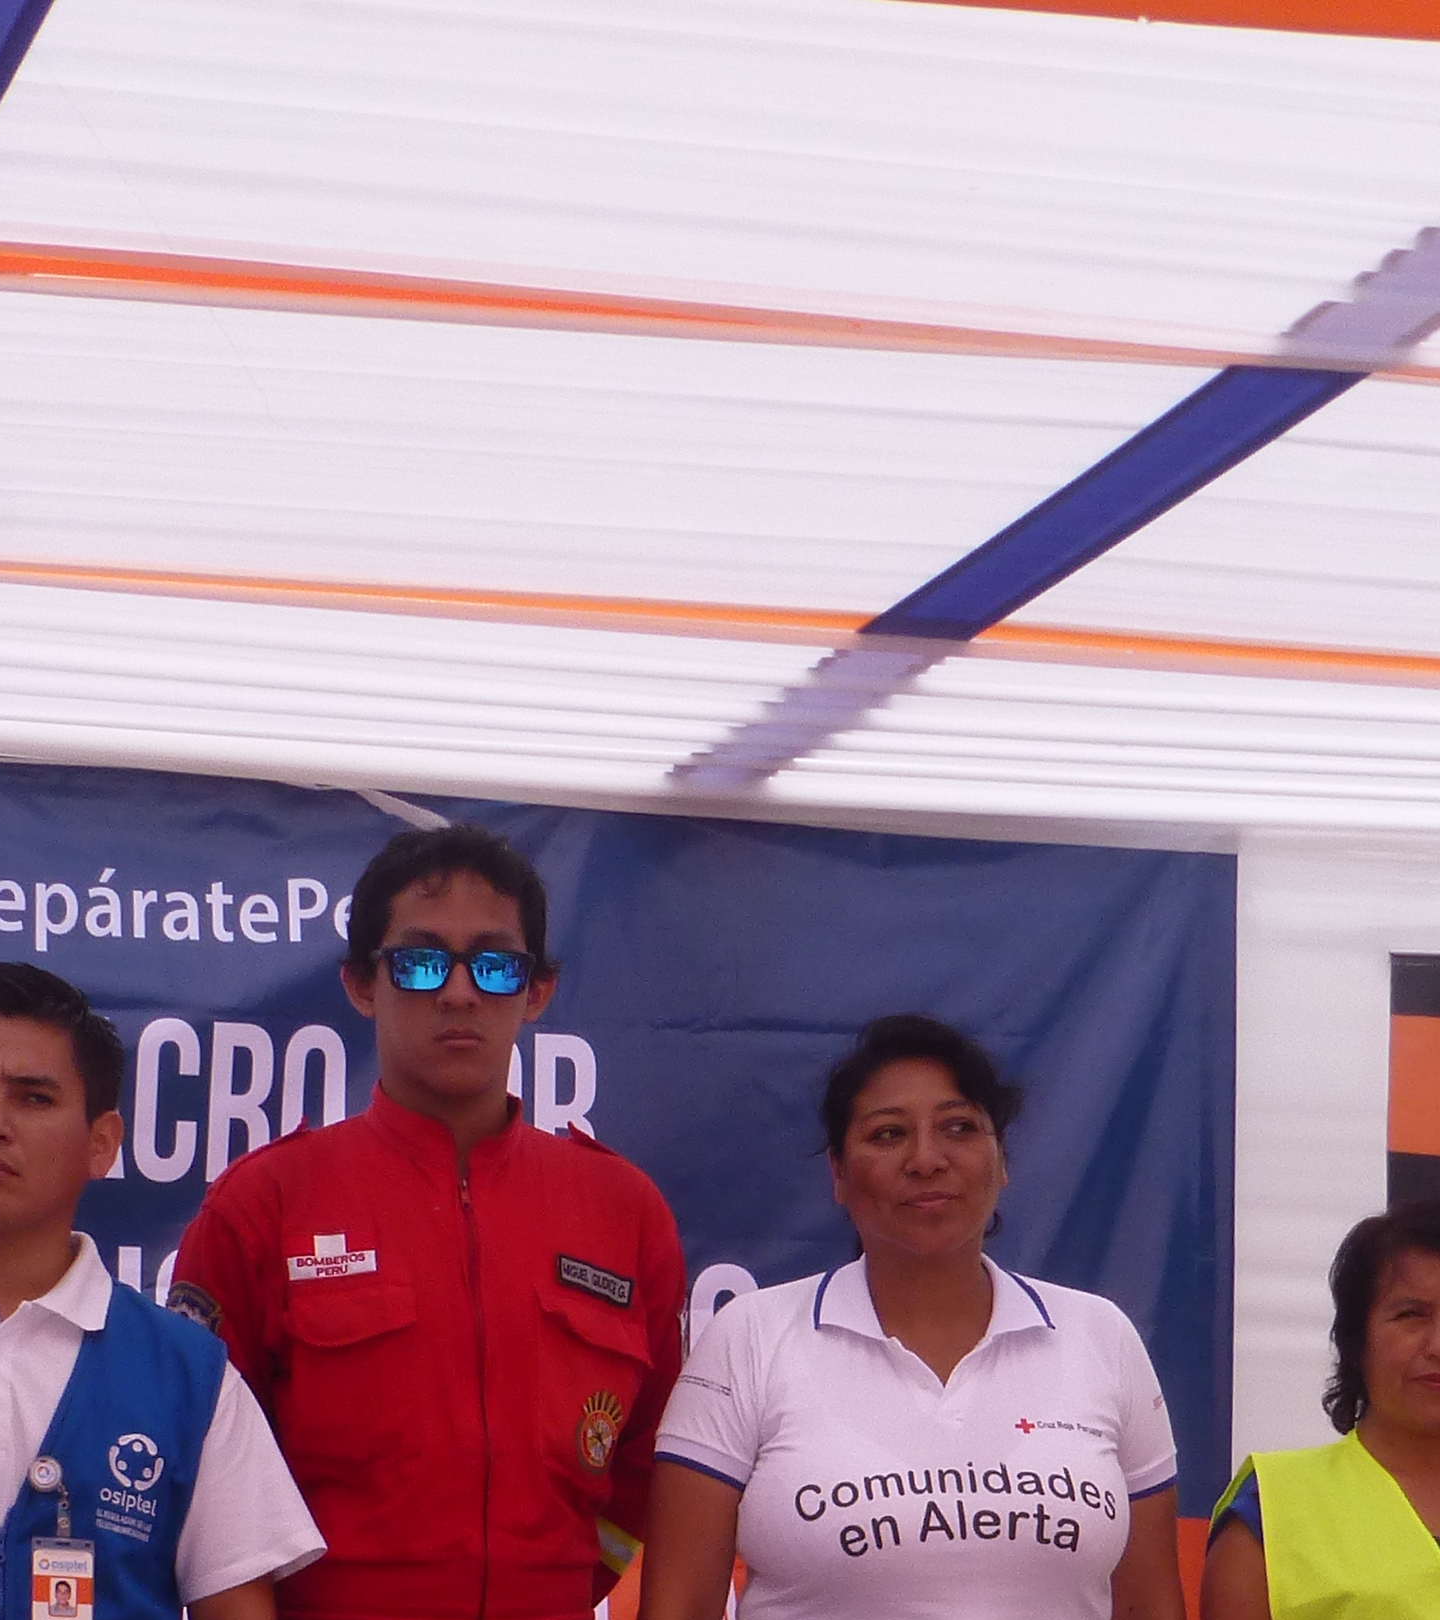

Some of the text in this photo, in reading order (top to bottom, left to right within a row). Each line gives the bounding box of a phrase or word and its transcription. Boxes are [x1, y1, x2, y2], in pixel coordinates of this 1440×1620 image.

[296, 1253, 366, 1268] BOMBEROS
[1036, 1420, 1056, 1430] Cruz
[99, 1487, 158, 1517] osiptel
[795, 1461, 1116, 1521] Comunidades
[839, 1500, 1081, 1557] en Alerta
